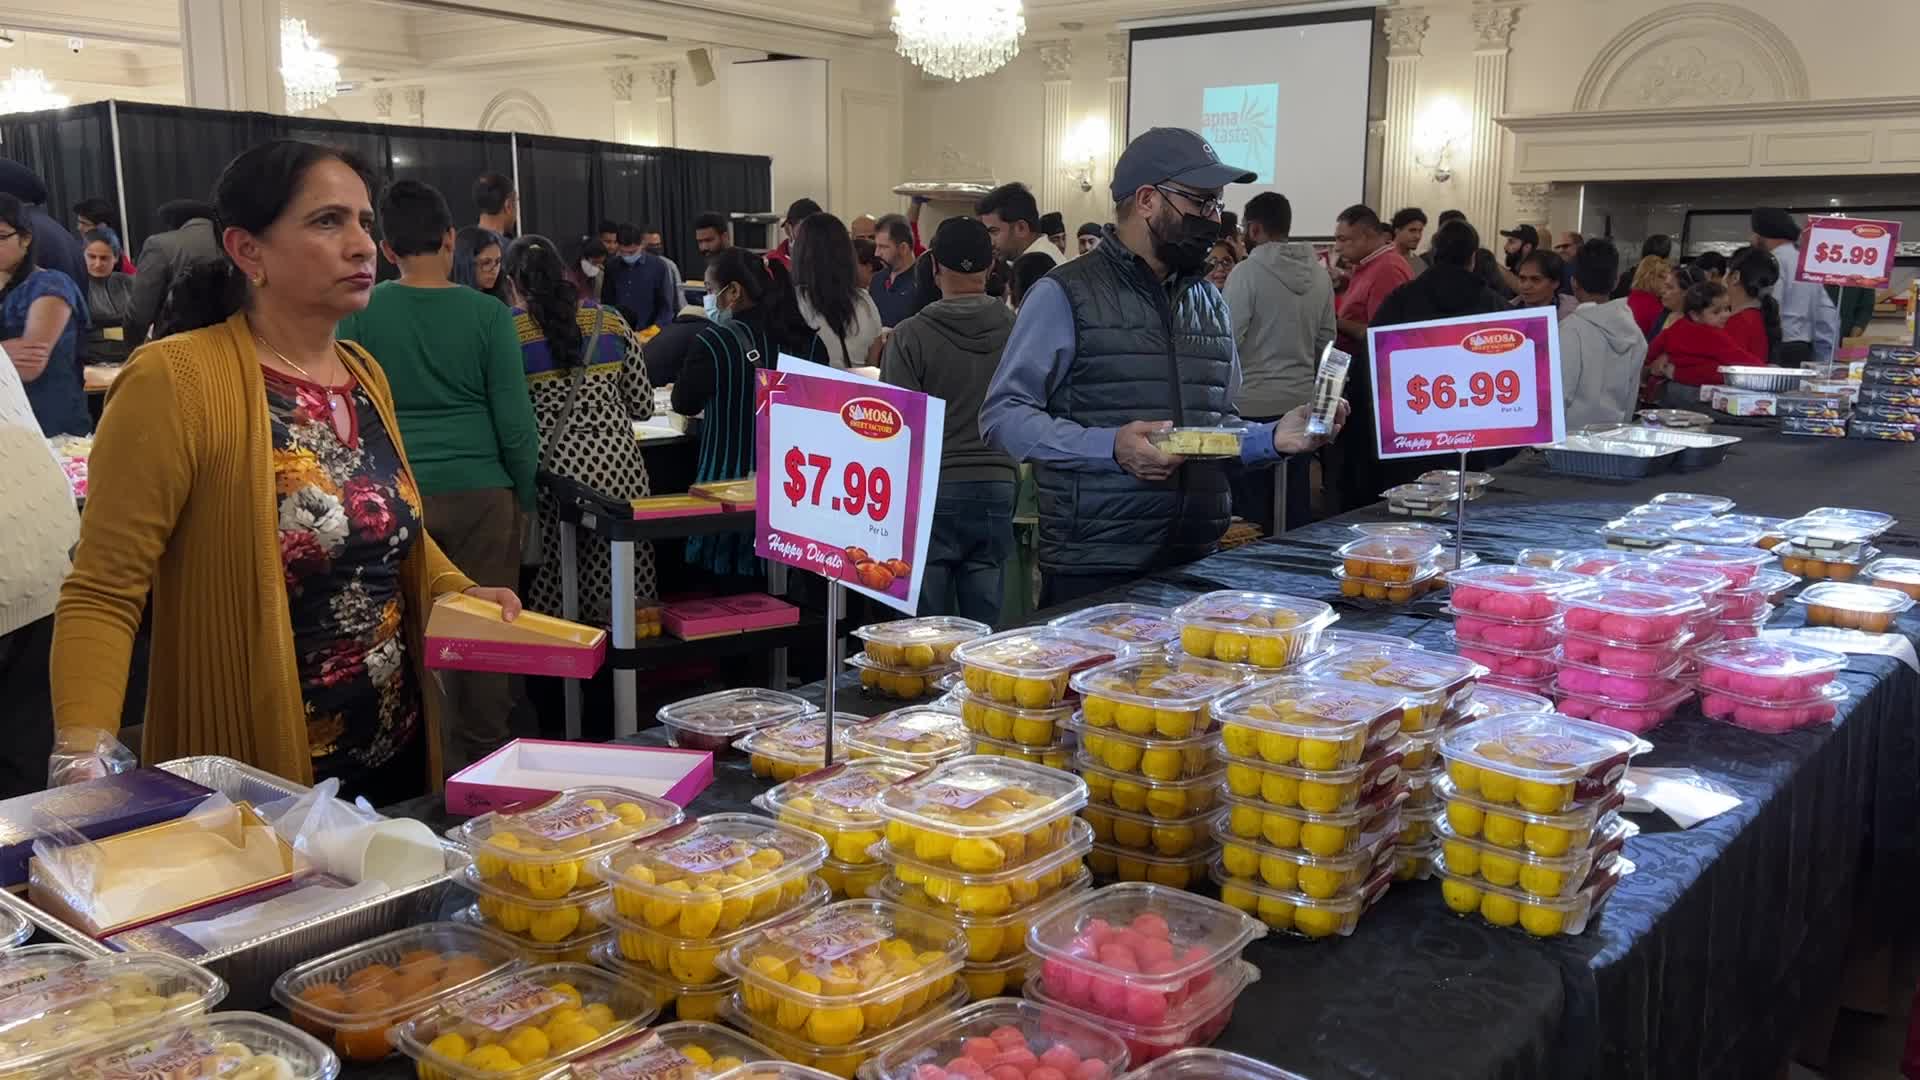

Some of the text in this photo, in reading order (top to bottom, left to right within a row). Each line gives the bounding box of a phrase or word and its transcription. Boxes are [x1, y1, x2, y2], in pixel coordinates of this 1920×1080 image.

[1200, 111, 1239, 132] apna
[1214, 127, 1250, 144] taste
[1814, 241, 1878, 266] $5.99
[1469, 334, 1516, 346] SAMOSA
[1406, 370, 1520, 415] $6.99
[848, 404, 894, 425] SAMOSA
[1394, 435, 1432, 450] Happy
[783, 445, 891, 521] $7.99
[869, 524, 889, 537] Per Lb
[768, 533, 803, 561] Happy
